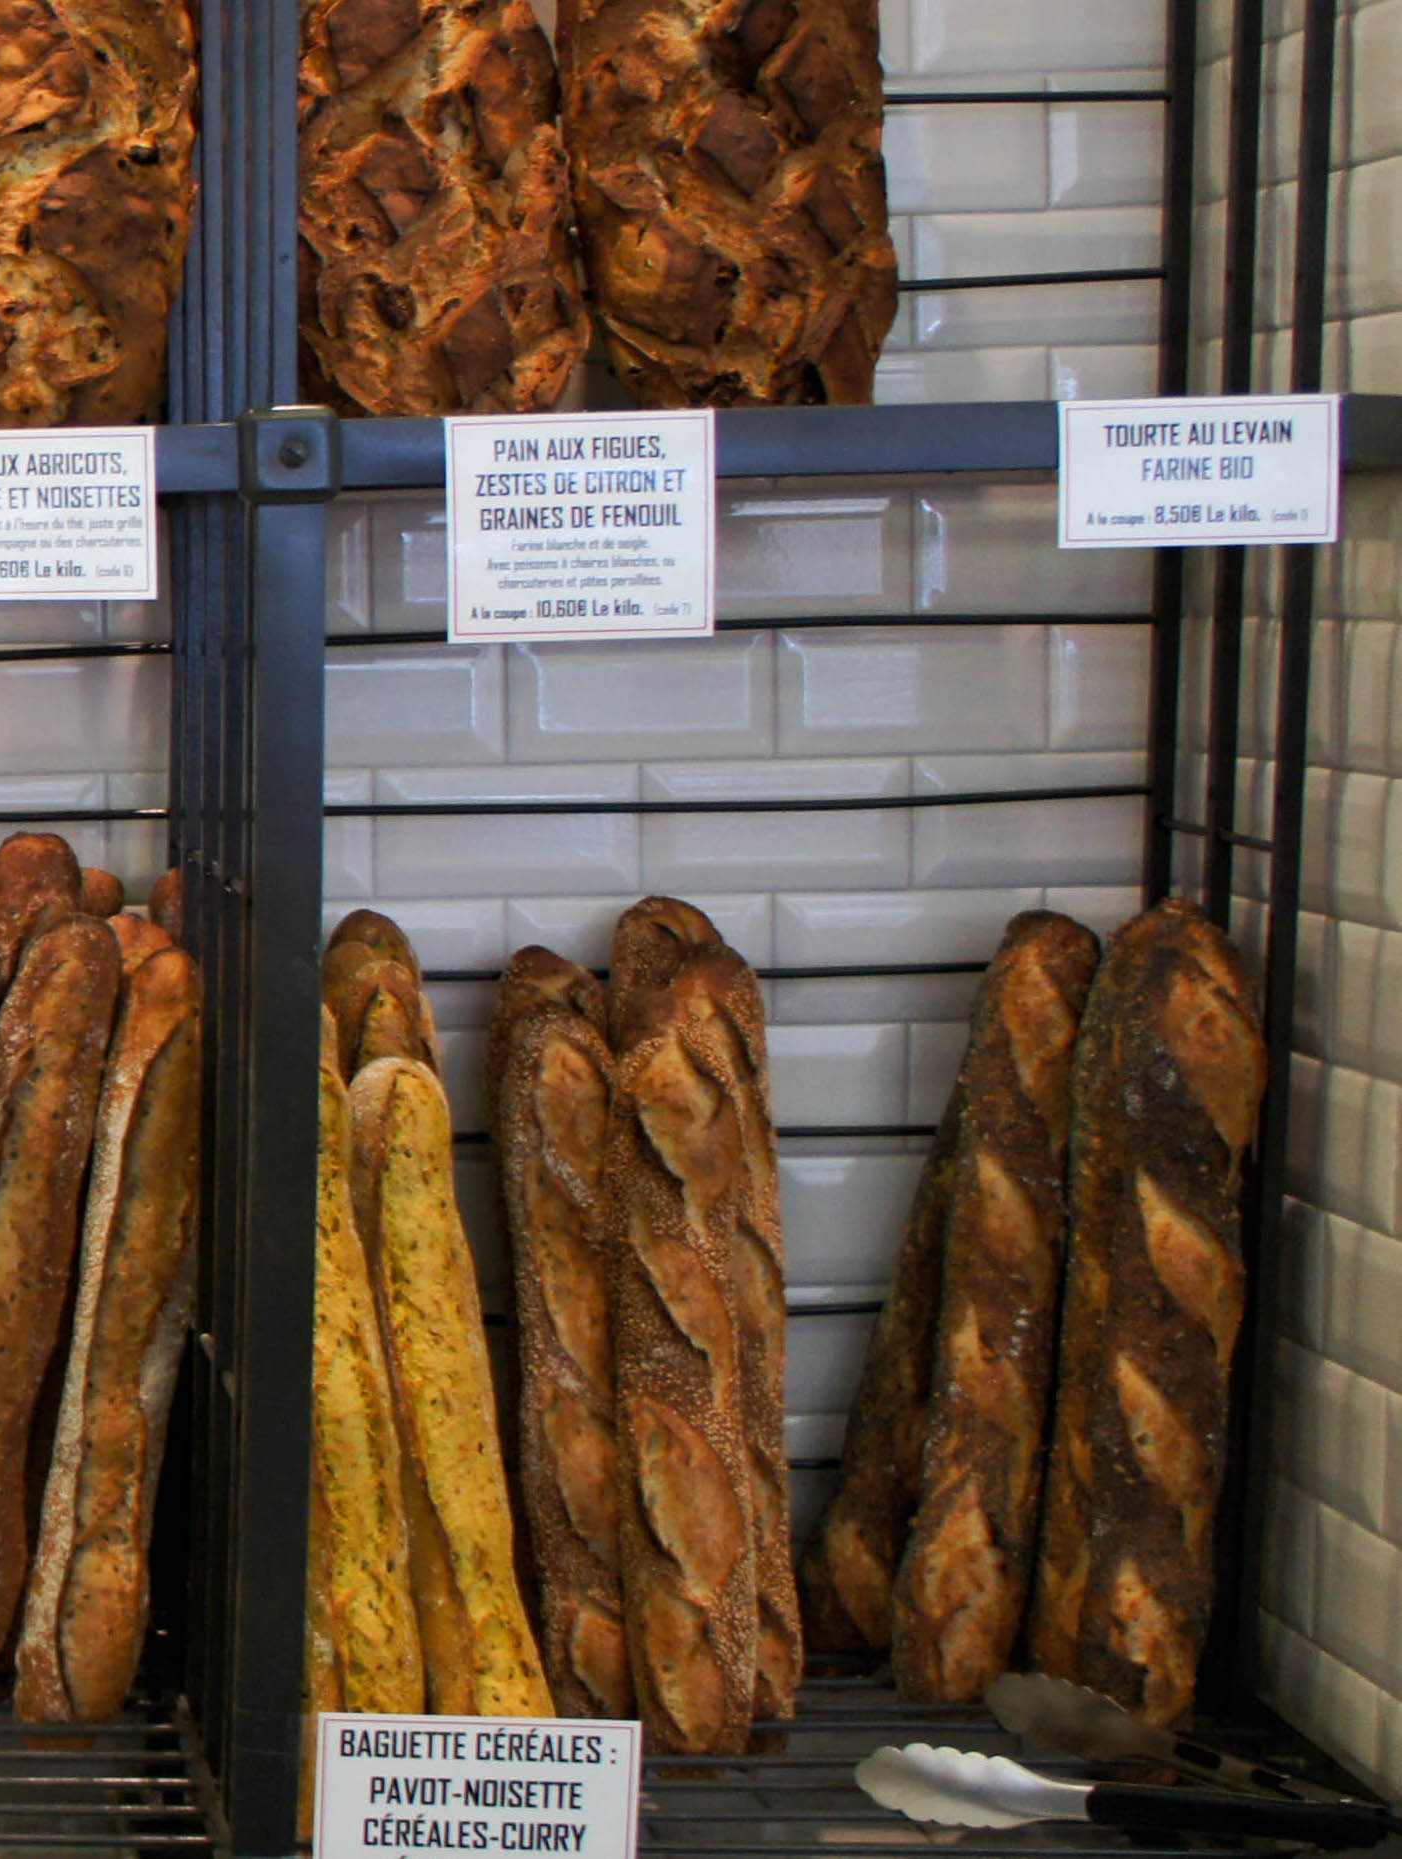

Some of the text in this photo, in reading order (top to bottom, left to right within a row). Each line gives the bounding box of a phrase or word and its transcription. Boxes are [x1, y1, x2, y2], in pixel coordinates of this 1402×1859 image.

[1104, 420, 1292, 447] TOURTE AU LEVAIN
[494, 436, 665, 462] PAIN AUX FIGUES,
[27, 453, 127, 476] ABRICOTS,
[1142, 456, 1253, 481] FARINE BIO
[476, 469, 685, 496] ZESTES DE CITRON ET
[9, 487, 30, 509] ET
[36, 486, 140, 508] NOISETTES
[481, 504, 681, 530] GRAINES DE FENOUIL
[1208, 505, 1223, 522] Le
[1230, 504, 1260, 521] kilo.
[35, 561, 51, 577] Le
[56, 560, 85, 577] kilo.
[471, 608, 478, 619] A
[481, 607, 490, 618] la
[494, 608, 526, 620] coupe
[537, 600, 586, 618] 10,60€
[592, 601, 609, 616] Le
[614, 599, 644, 615] kilo.
[340, 1729, 467, 1760] BAGUETTE
[475, 1728, 602, 1764] CÉRÉALES
[370, 1776, 583, 1809] PAVOT-NOISETTE
[363, 1814, 586, 1852] CÉRÉALES-CURRY
